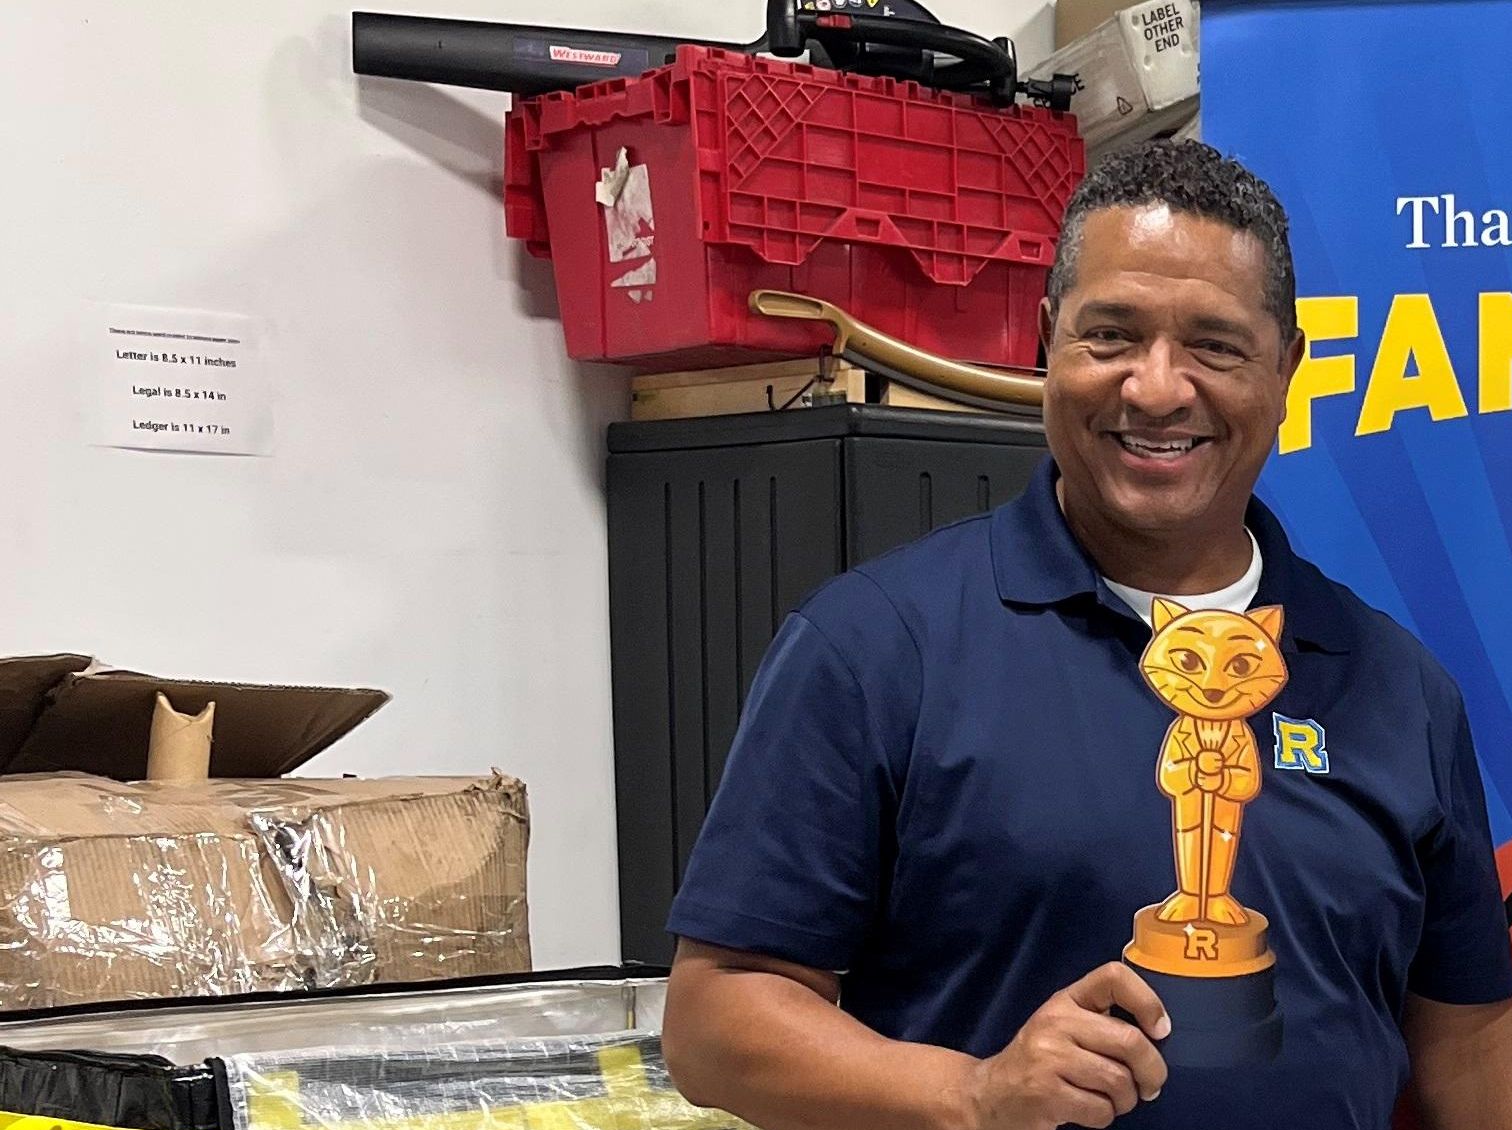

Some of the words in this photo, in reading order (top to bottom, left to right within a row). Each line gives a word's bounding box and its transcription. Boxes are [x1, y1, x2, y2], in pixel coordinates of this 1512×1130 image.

[1142, 3, 1180, 26] LABEL
[1144, 16, 1184, 41] OTHER
[1155, 34, 1180, 53] END
[552, 48, 619, 64] WESTWARD
[116, 350, 147, 360] Letter
[150, 351, 159, 361] is
[162, 353, 178, 363] 8.5
[189, 355, 201, 365] 11
[204, 356, 237, 368] inches
[132, 385, 161, 397] Legal
[164, 387, 173, 397] is
[175, 389, 191, 398] 8.5
[193, 391, 200, 399] x
[202, 390, 214, 400] 14
[217, 391, 227, 400] in
[132, 420, 168, 432] Ledger
[171, 422, 179, 432] is
[183, 423, 194, 433] 11
[206, 424, 218, 434] 17
[221, 425, 230, 434] in
[1273, 711, 1330, 773] R
[1184, 924, 1219, 961] R
